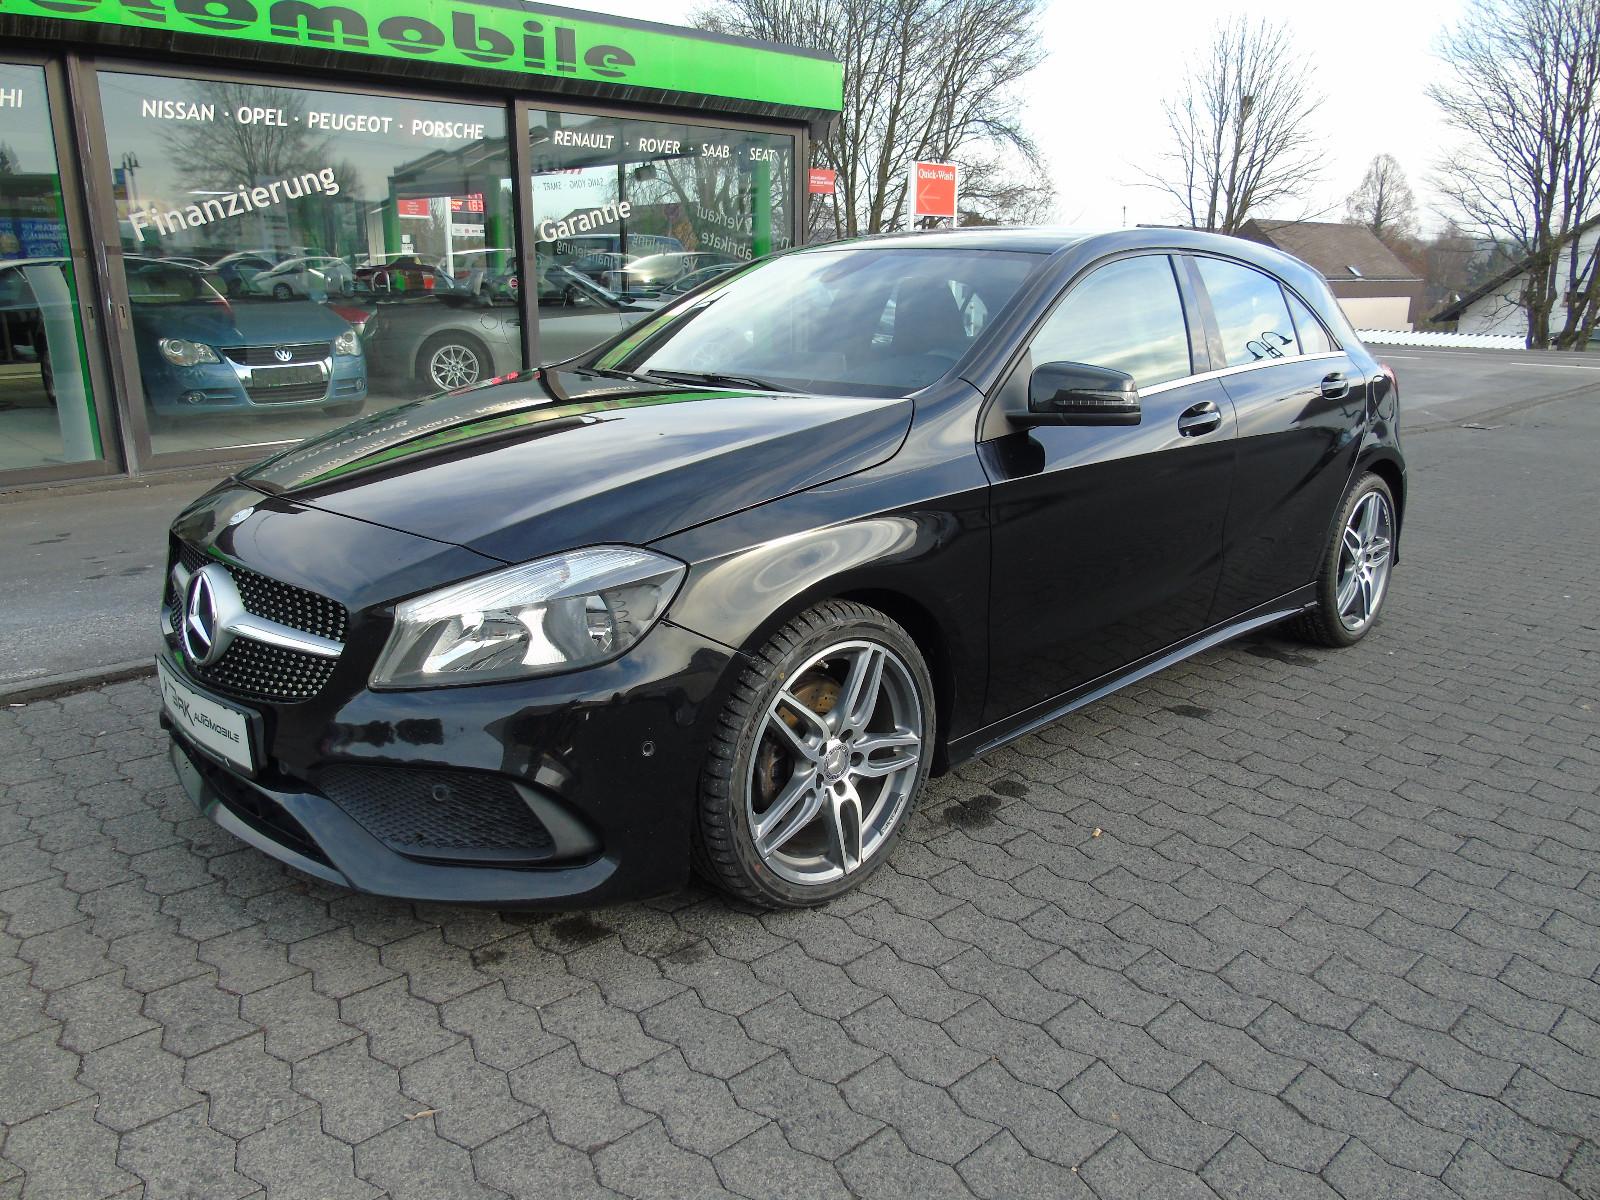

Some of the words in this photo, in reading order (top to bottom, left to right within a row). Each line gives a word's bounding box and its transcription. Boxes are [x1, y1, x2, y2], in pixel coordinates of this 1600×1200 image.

[142, 99, 215, 122] NISSAN
[237, 107, 288, 127] OPEL
[308, 112, 392, 134] PEUGEOT
[412, 120, 485, 140] PORSCHE
[554, 130, 615, 150] RENAULT
[639, 137, 681, 155] ROVER
[702, 143, 730, 159] SAAB
[750, 148, 776, 162] SEAT
[129, 167, 339, 242] Finanzierung
[540, 199, 632, 243] Garantie
